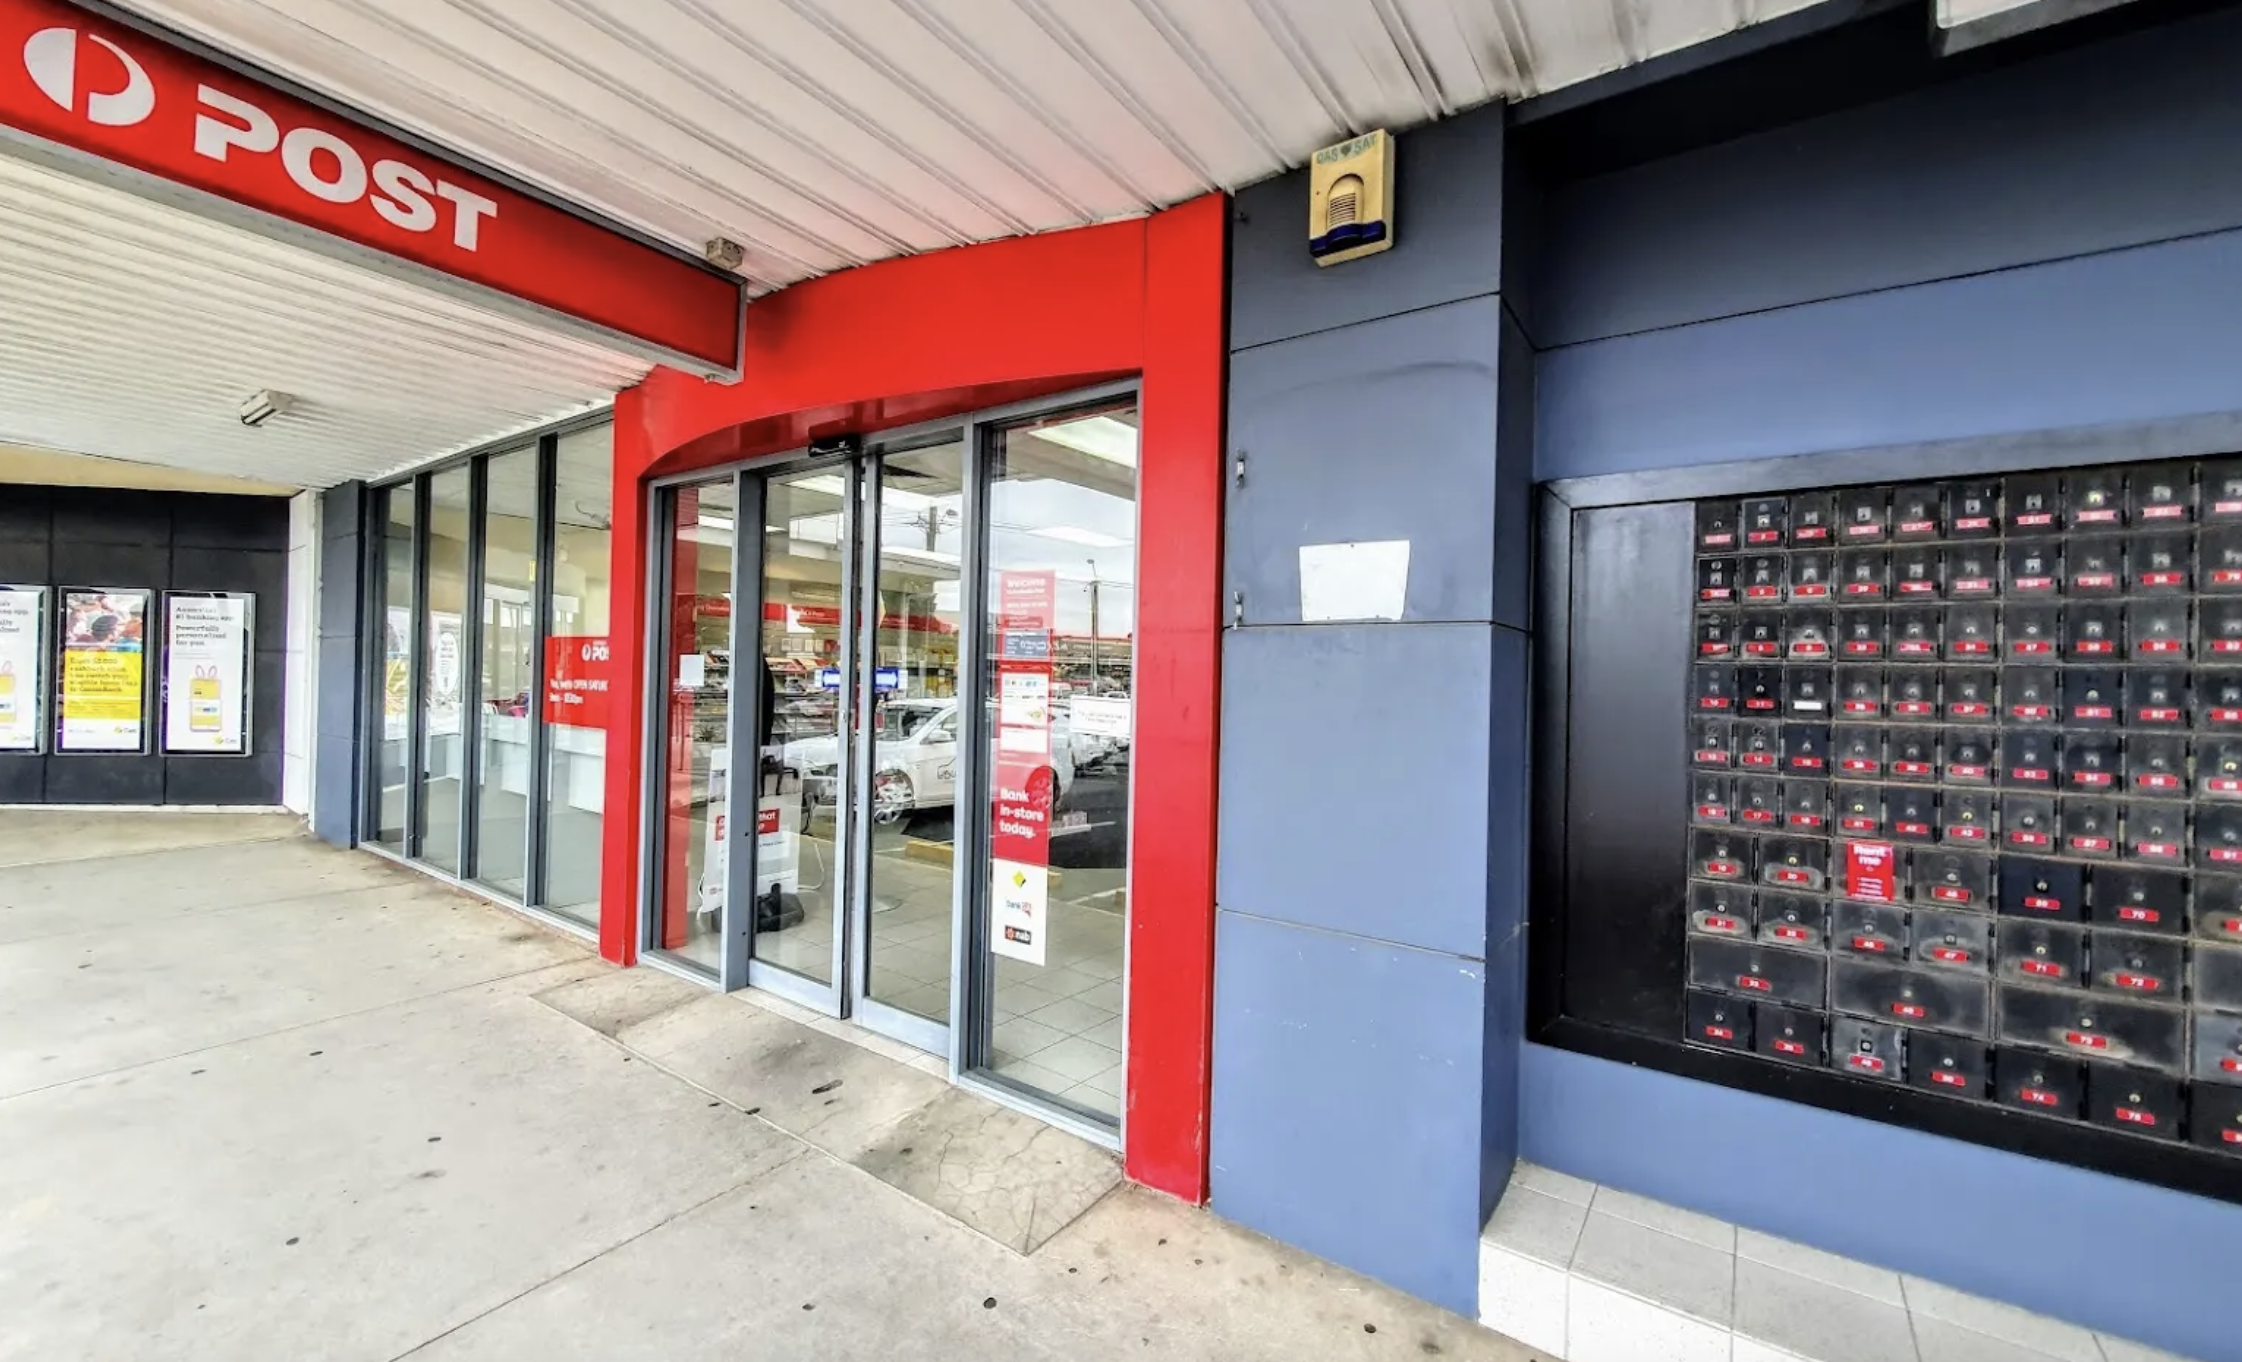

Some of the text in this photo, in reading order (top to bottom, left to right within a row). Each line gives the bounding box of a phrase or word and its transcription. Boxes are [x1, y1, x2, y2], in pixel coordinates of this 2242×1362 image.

[195, 83, 497, 253] POST
[1000, 787, 1030, 803] Bank
[1000, 804, 1045, 822] in-store
[999, 820, 1037, 839] today.
[1853, 844, 1886, 857] Rent
[1859, 856, 1882, 866] me
